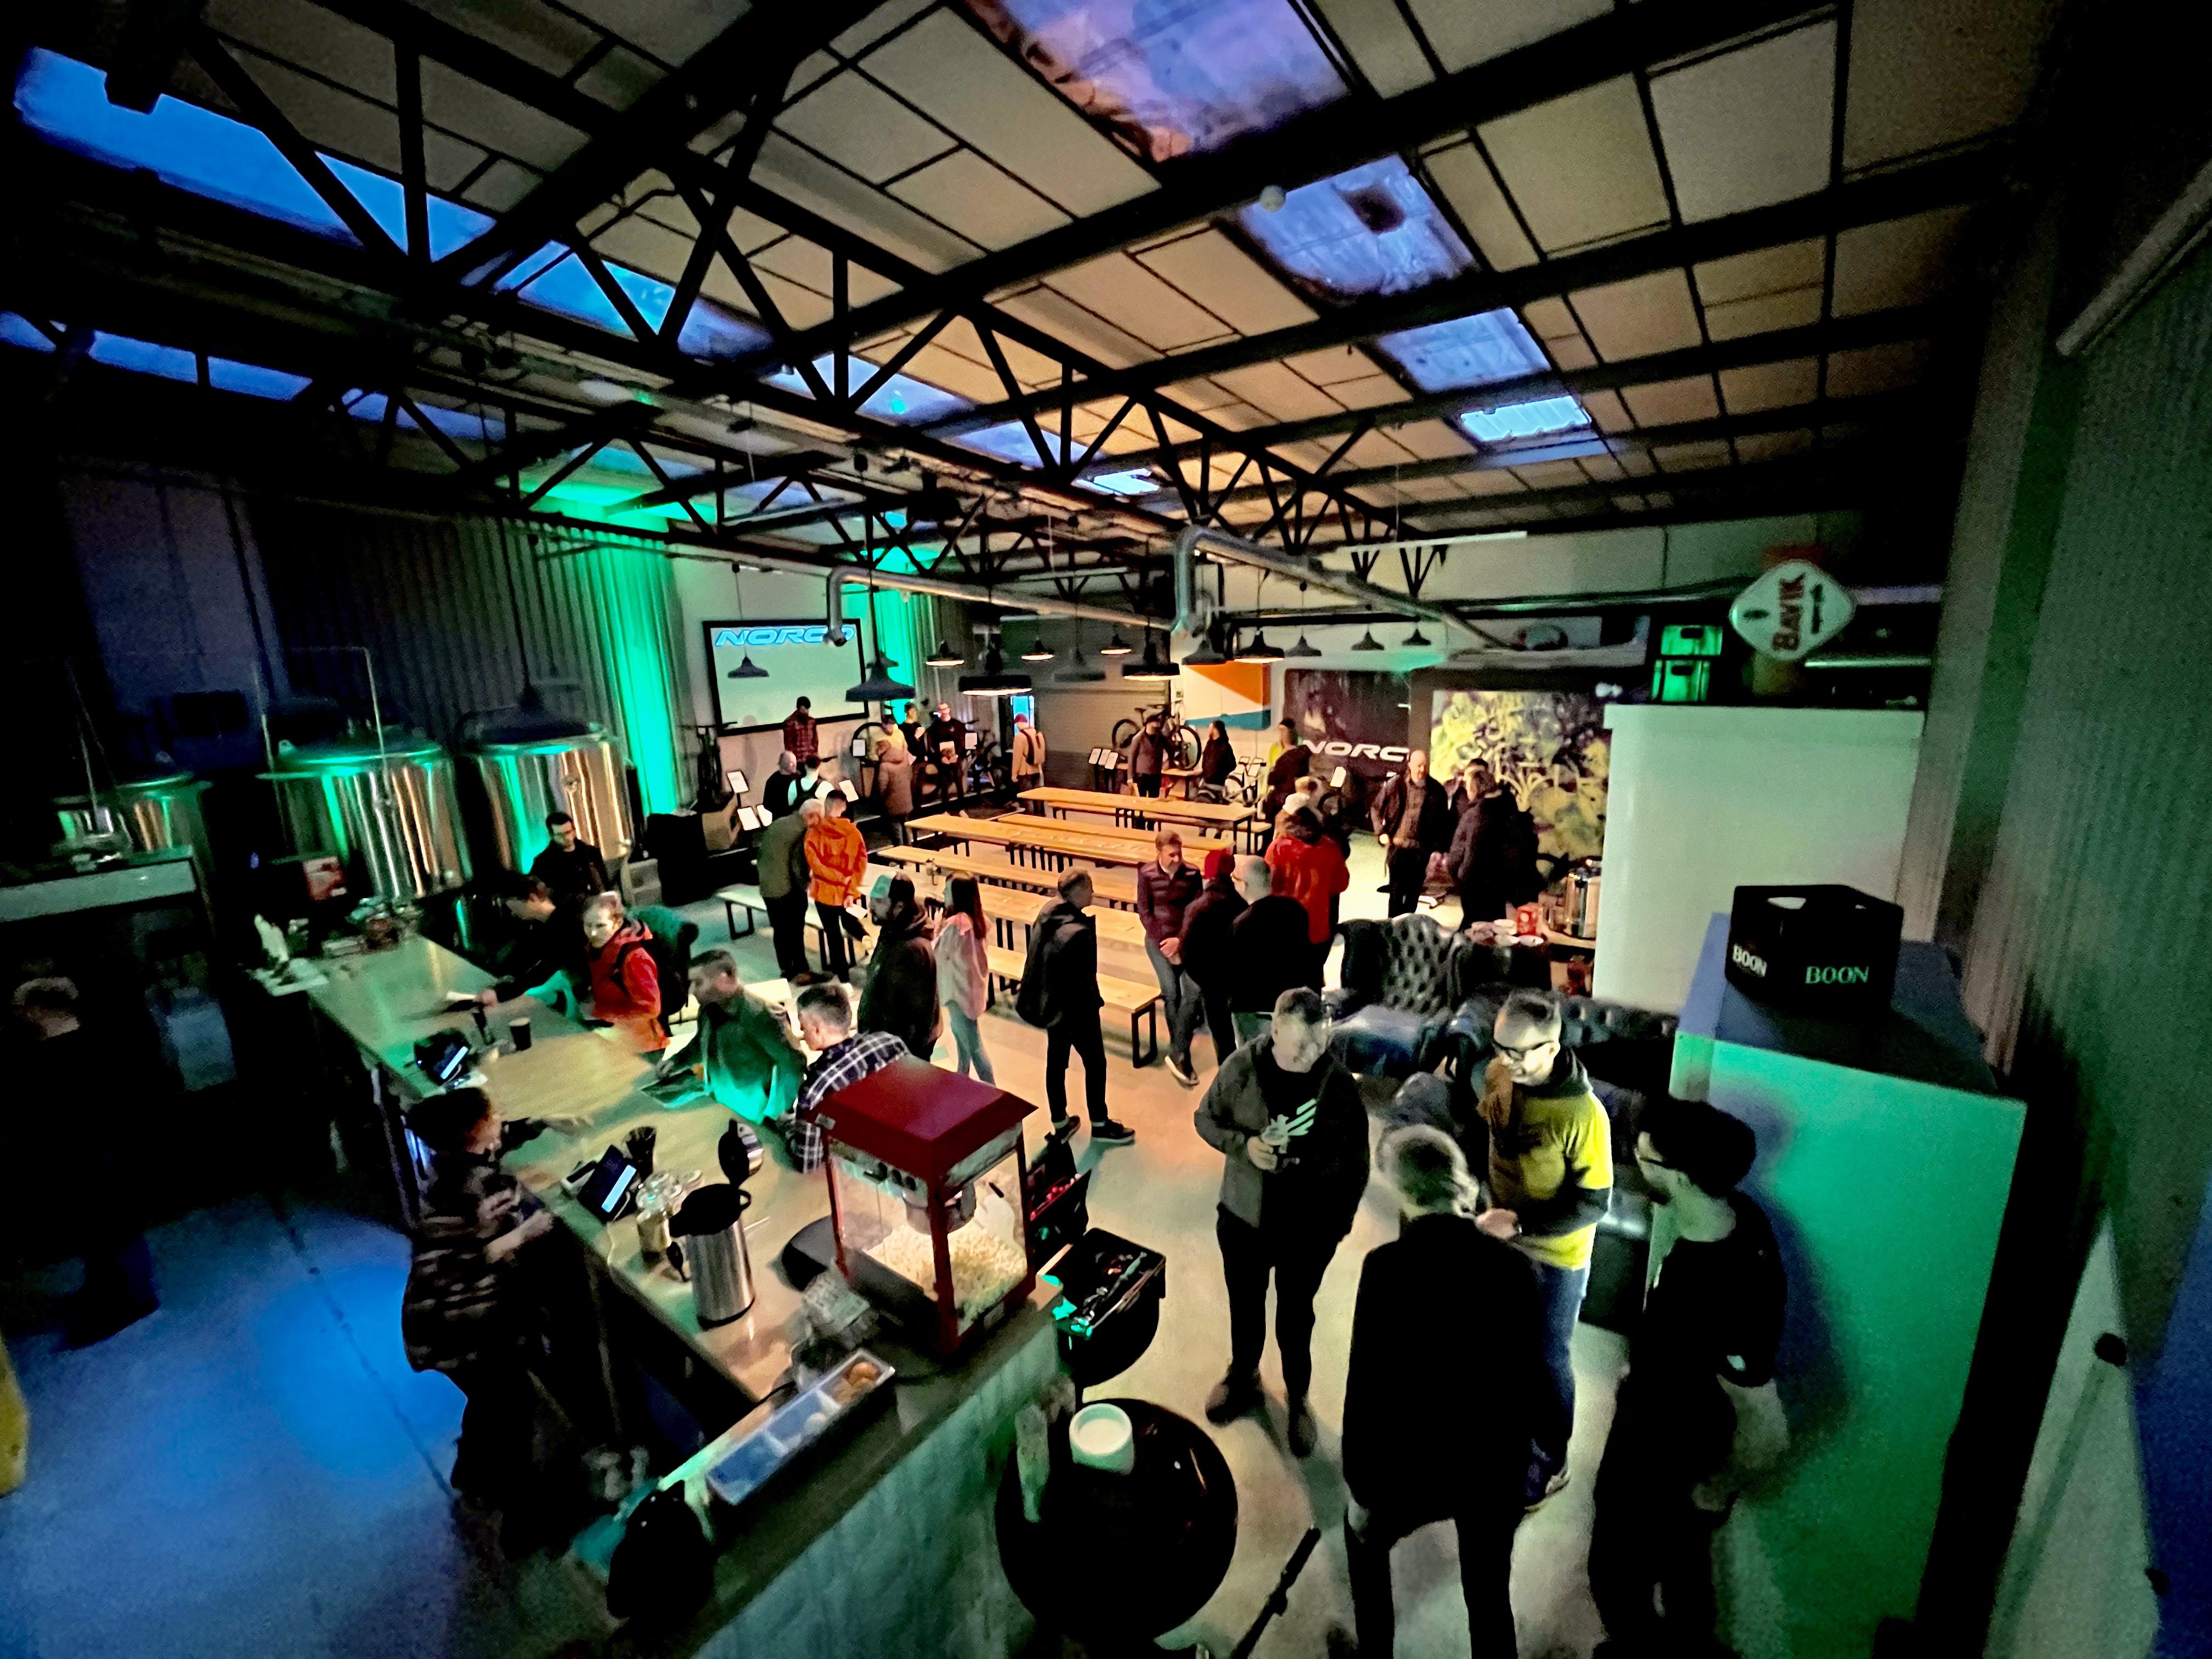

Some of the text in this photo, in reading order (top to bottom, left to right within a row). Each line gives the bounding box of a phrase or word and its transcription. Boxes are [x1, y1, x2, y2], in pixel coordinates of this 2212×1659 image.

[1303, 740, 1410, 761] NORC
[1732, 943, 1767, 978] BOON
[1805, 966, 1869, 984] BOON
